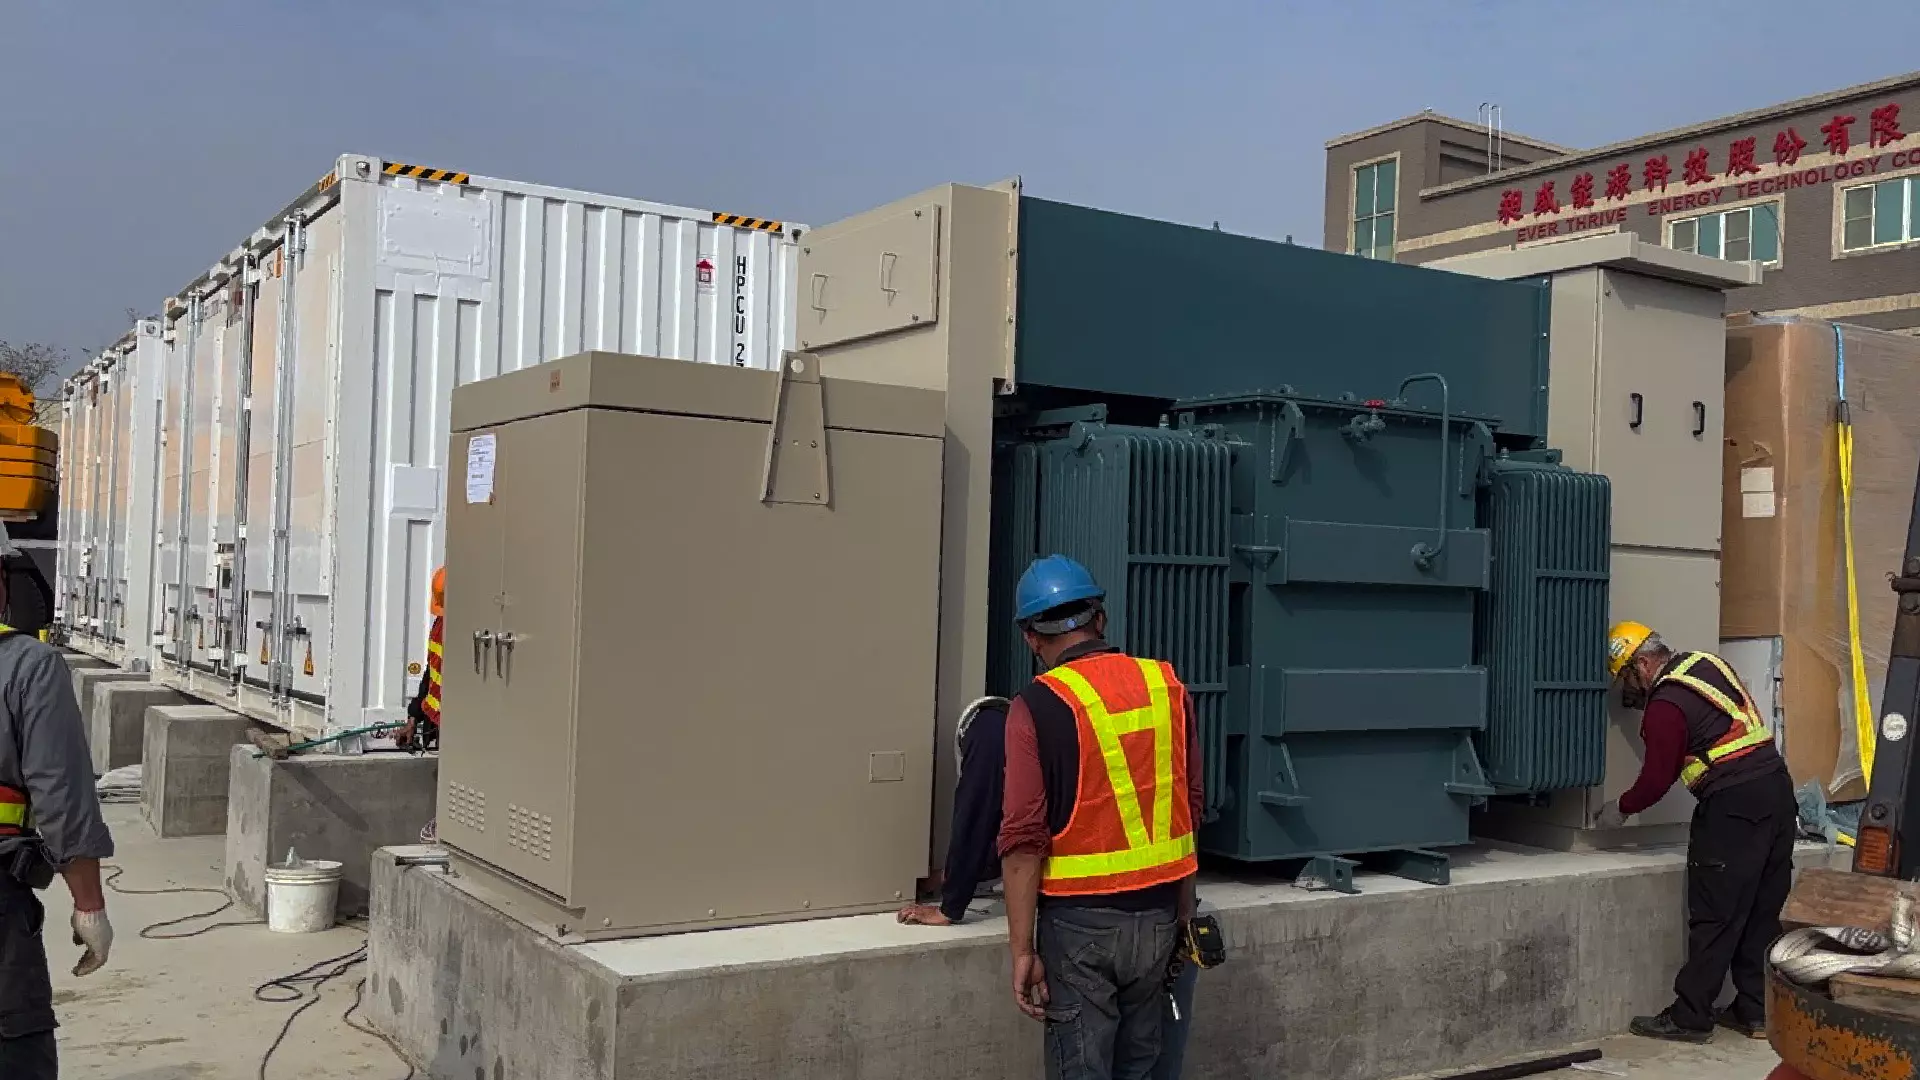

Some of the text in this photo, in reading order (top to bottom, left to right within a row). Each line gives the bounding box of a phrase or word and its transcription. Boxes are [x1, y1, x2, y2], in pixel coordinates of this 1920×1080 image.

[1517, 221, 1559, 242] EVER
[1565, 207, 1628, 233] THRIVE
[1648, 187, 1724, 216] ENERGY
[1736, 155, 1883, 199] TECHNOLOGY
[735, 255, 747, 335] HPCU
